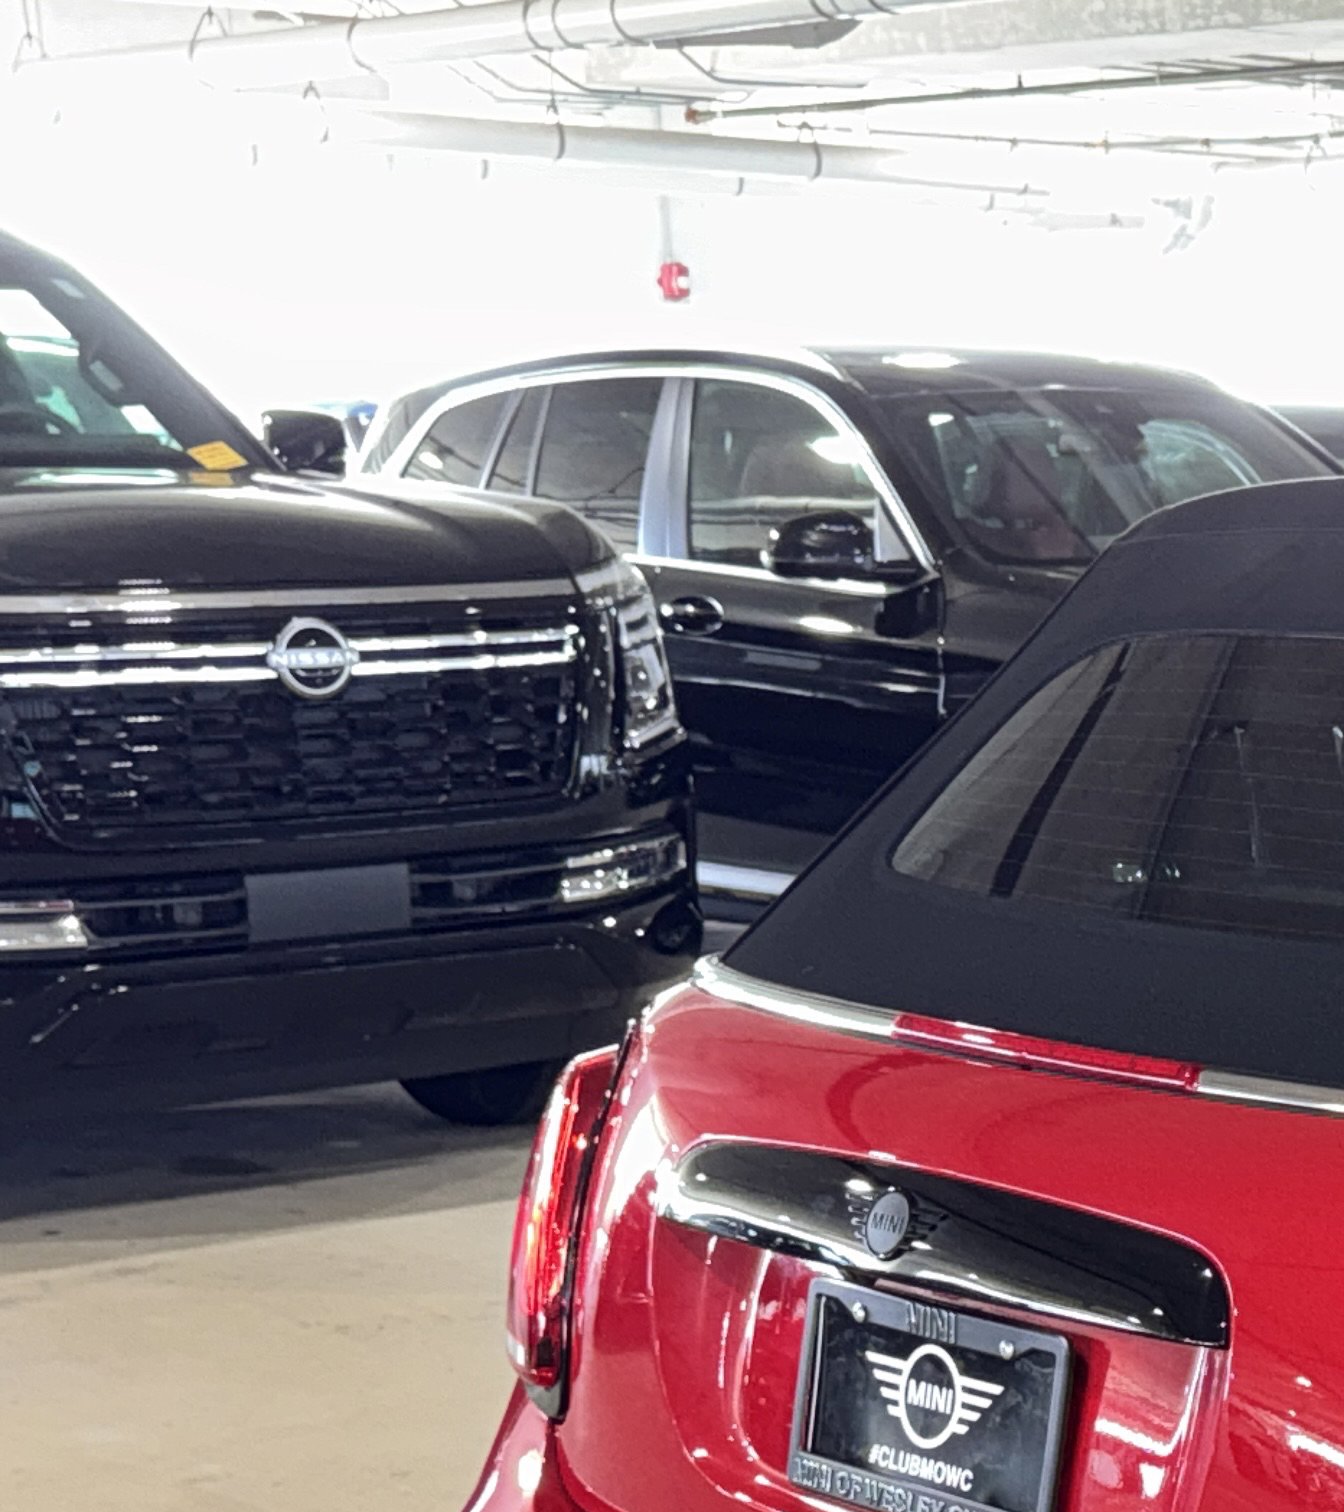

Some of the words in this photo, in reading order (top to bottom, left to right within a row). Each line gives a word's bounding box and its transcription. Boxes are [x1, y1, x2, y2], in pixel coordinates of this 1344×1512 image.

[272, 651, 357, 667] NISSAN
[870, 1212, 906, 1235] MINI
[905, 1303, 957, 1344] MINI
[907, 1378, 954, 1414] MINI
[868, 1443, 974, 1492] #CLUBMOWC
[836, 1470, 862, 1500] OF
